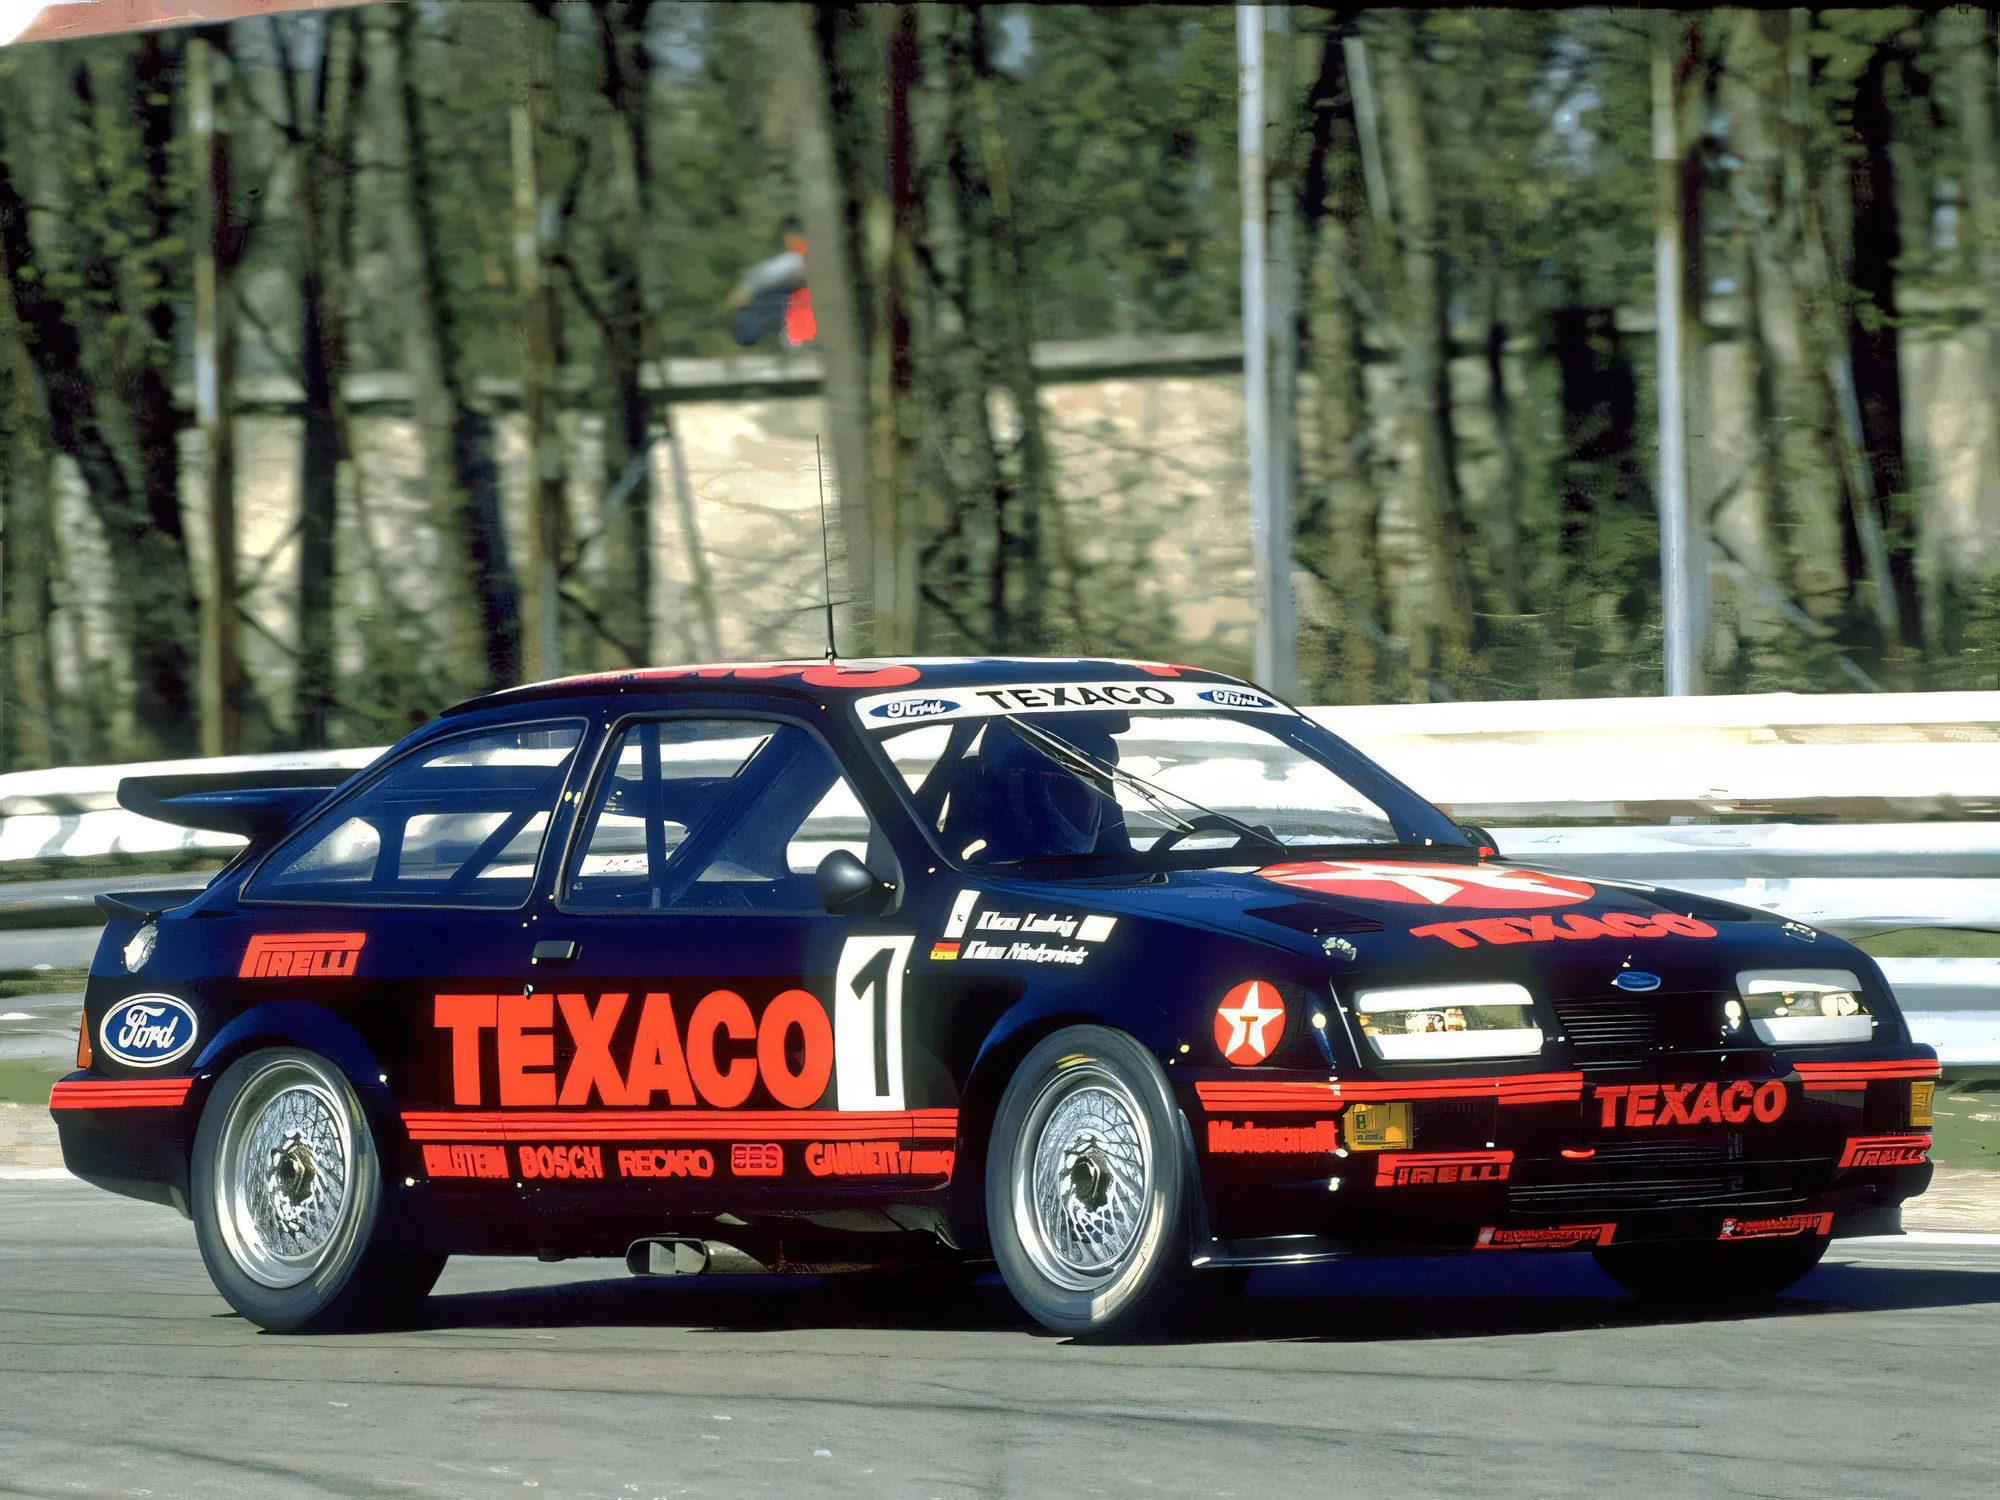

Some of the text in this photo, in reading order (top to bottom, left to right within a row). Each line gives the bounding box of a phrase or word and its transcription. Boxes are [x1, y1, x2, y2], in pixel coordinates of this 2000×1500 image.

[976, 685, 1176, 710] TEXACO
[1408, 912, 1718, 949] TEXACO
[237, 932, 367, 978] PIRELLI
[118, 1004, 179, 1049] Ford
[850, 947, 897, 1097] 1
[434, 989, 834, 1109] TEXACO
[1594, 1080, 1788, 1128] TEXACO
[518, 1145, 604, 1179] BOSCH
[617, 1148, 714, 1178] RECARO
[1375, 1150, 1515, 1187] PIRELLI
